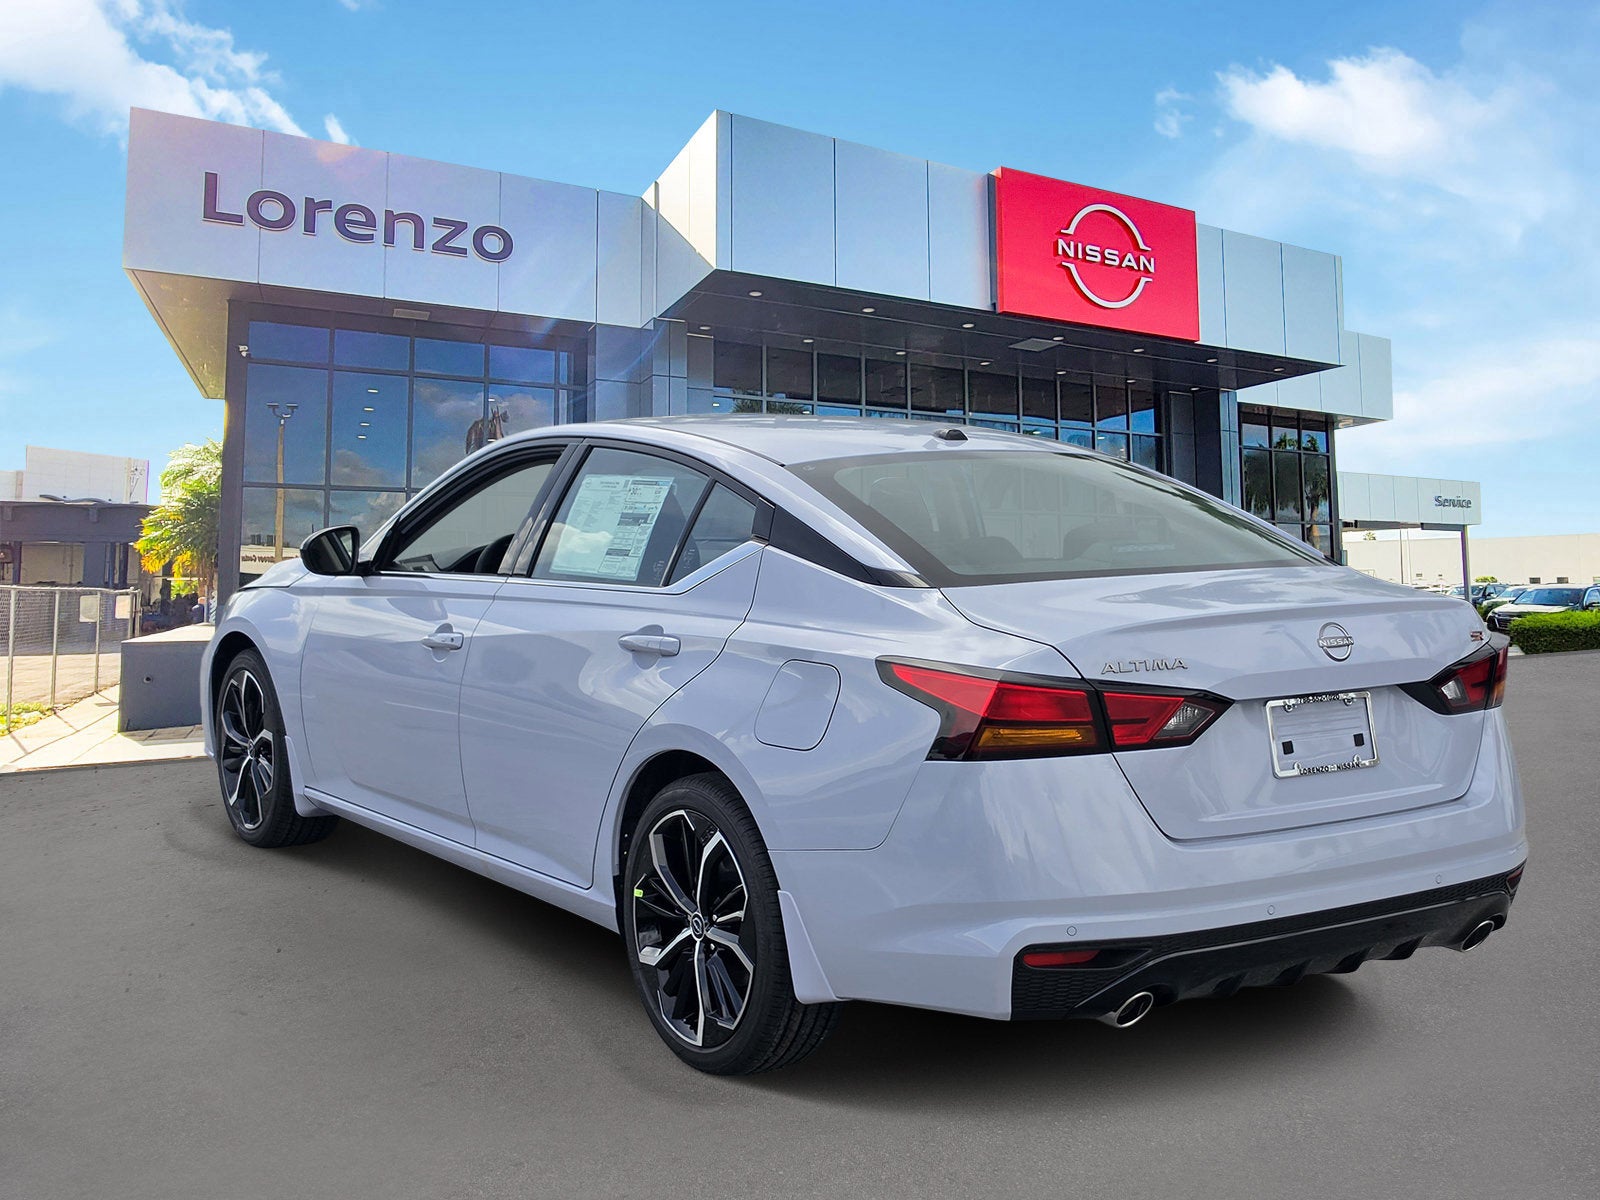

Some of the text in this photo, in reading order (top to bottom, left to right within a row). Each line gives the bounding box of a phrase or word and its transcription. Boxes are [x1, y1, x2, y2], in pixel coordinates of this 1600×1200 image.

[202, 171, 514, 263] Lorenzo
[1057, 238, 1155, 273] NISSAN
[1434, 495, 1472, 509] Service
[1319, 637, 1354, 647] NISSAN
[1101, 658, 1188, 675] ALTIMA
[1300, 761, 1361, 776] LORENZO NISSAN
